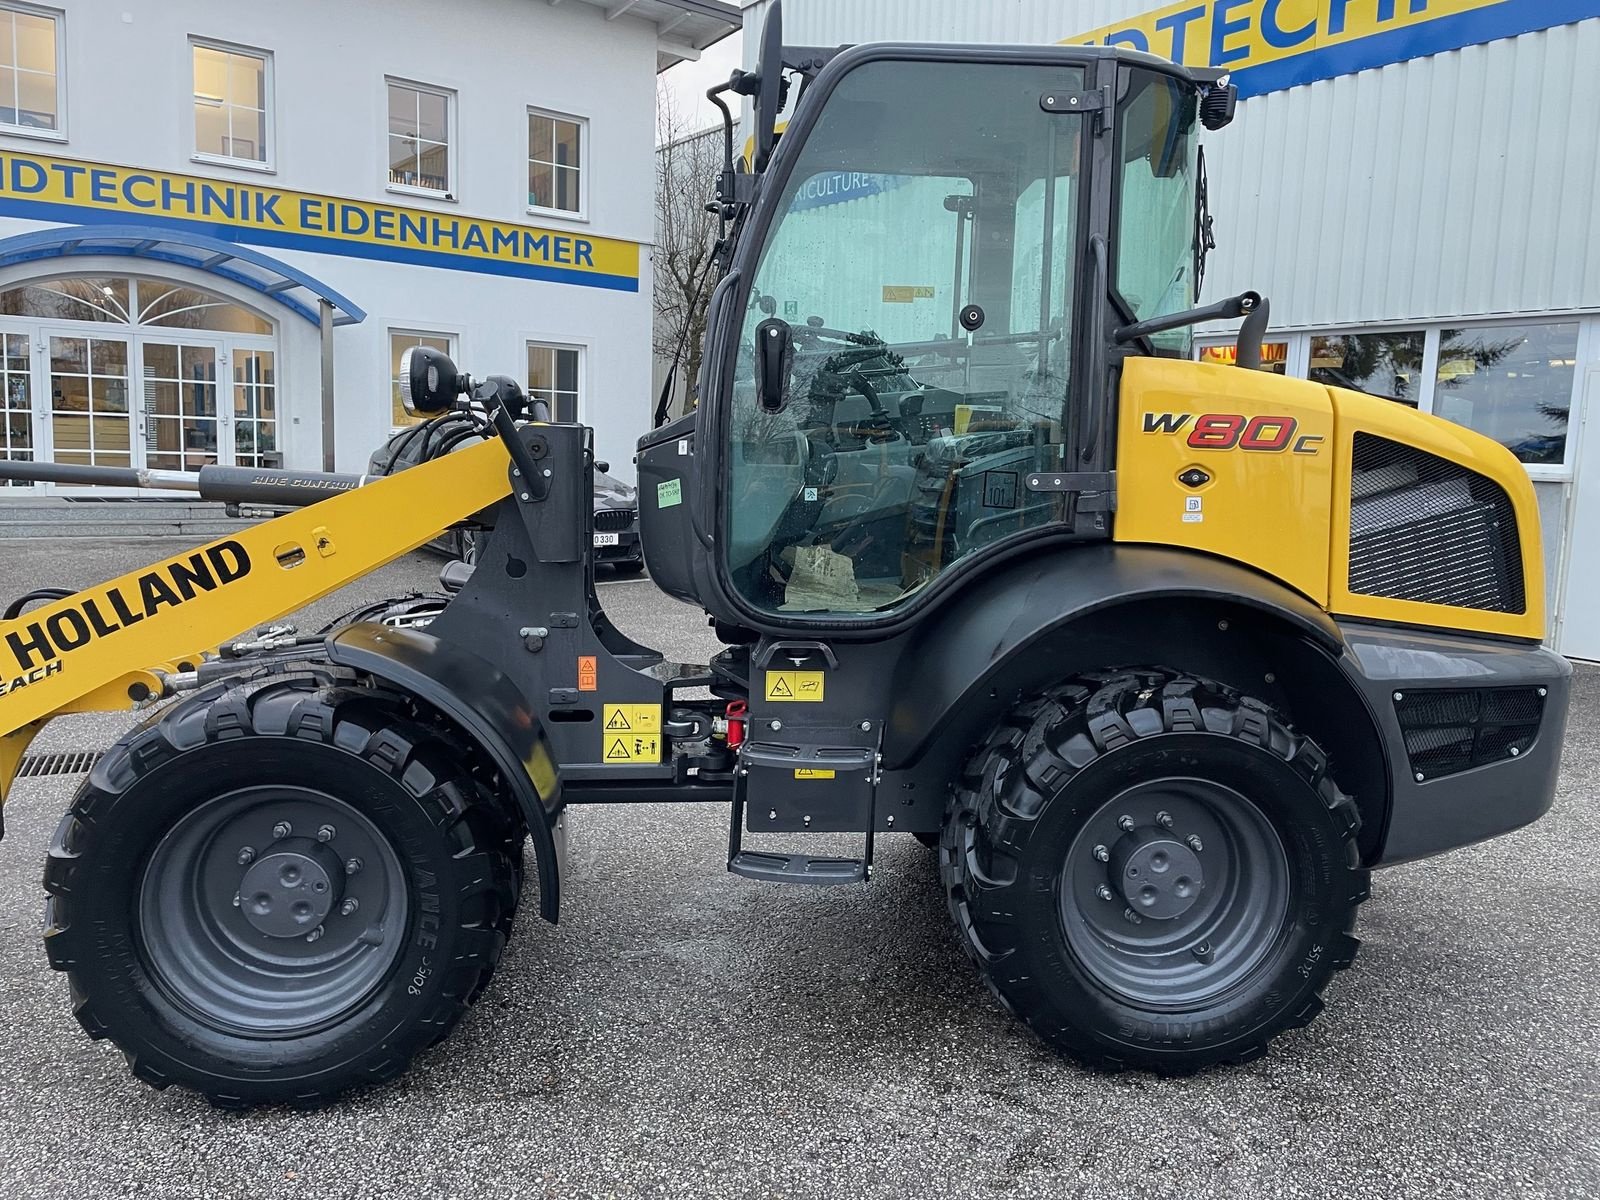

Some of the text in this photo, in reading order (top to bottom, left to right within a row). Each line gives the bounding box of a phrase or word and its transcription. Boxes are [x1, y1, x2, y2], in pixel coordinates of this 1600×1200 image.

[0, 157, 595, 268] DTECHNIK EIDENHAMMER
[251, 475, 289, 487] RIDE
[4, 540, 252, 671] HOLLAND
